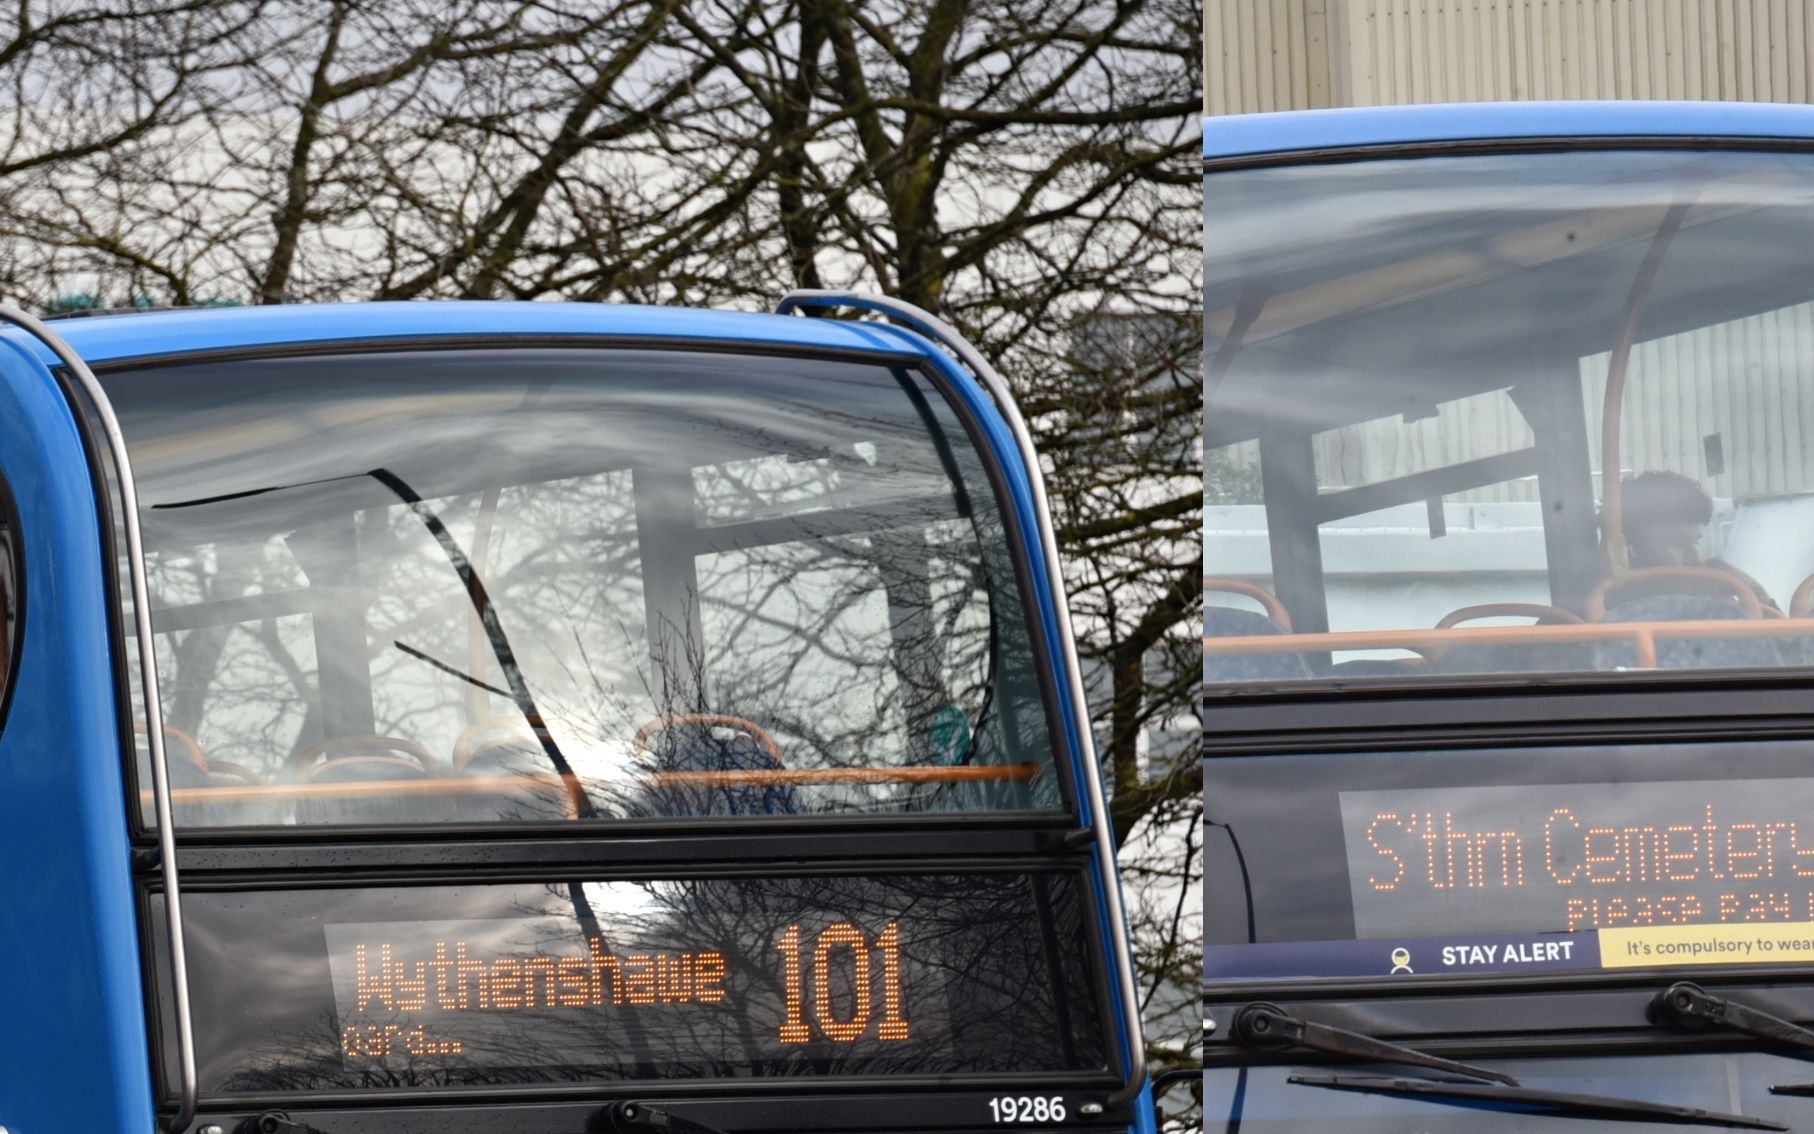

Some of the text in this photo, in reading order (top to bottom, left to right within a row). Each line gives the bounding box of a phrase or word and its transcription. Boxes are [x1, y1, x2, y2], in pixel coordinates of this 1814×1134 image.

[1367, 812, 1523, 889] S'thrn
[1442, 940, 1575, 966] STAY ALERT
[1627, 940, 1651, 956] It's
[1656, 937, 1751, 958] compulsory
[1756, 935, 1773, 951] to
[356, 936, 726, 1012] Wythenshawe
[776, 919, 909, 1044] 101
[989, 1096, 1067, 1123] 19286
